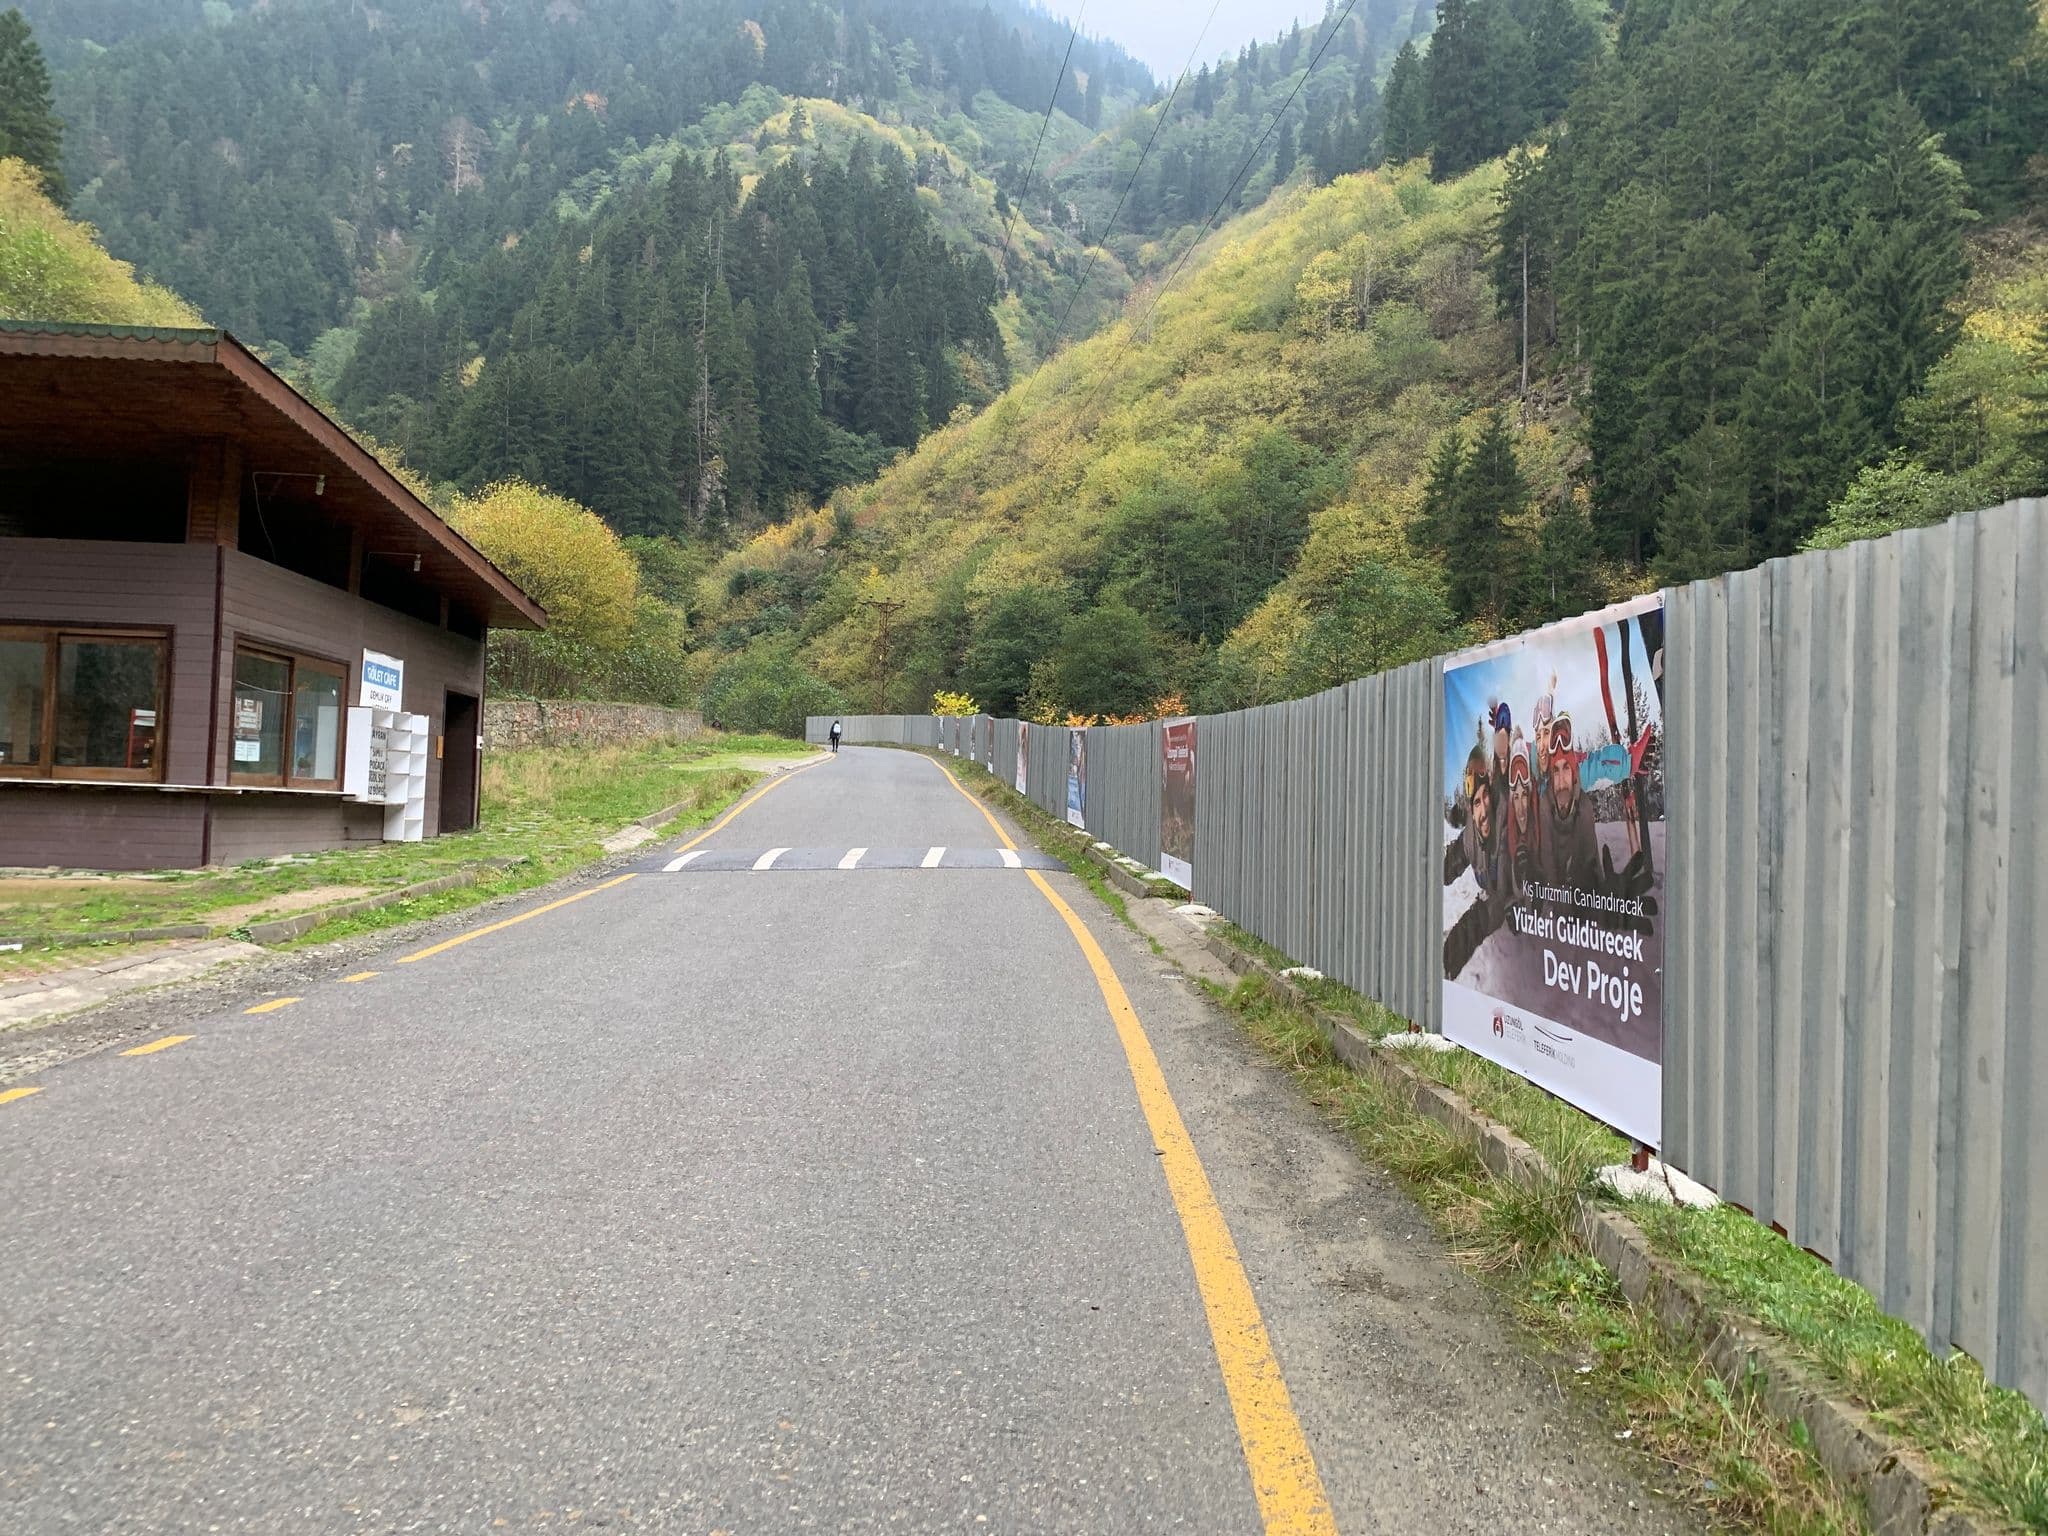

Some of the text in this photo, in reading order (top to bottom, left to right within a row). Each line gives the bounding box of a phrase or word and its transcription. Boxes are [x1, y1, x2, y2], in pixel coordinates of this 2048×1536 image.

[1522, 880, 1644, 917] Kış Turizmini Canlandıracak
[1513, 906, 1644, 962] Yüzleri Güldürecek
[1543, 949, 1643, 1023] Dev Proje
